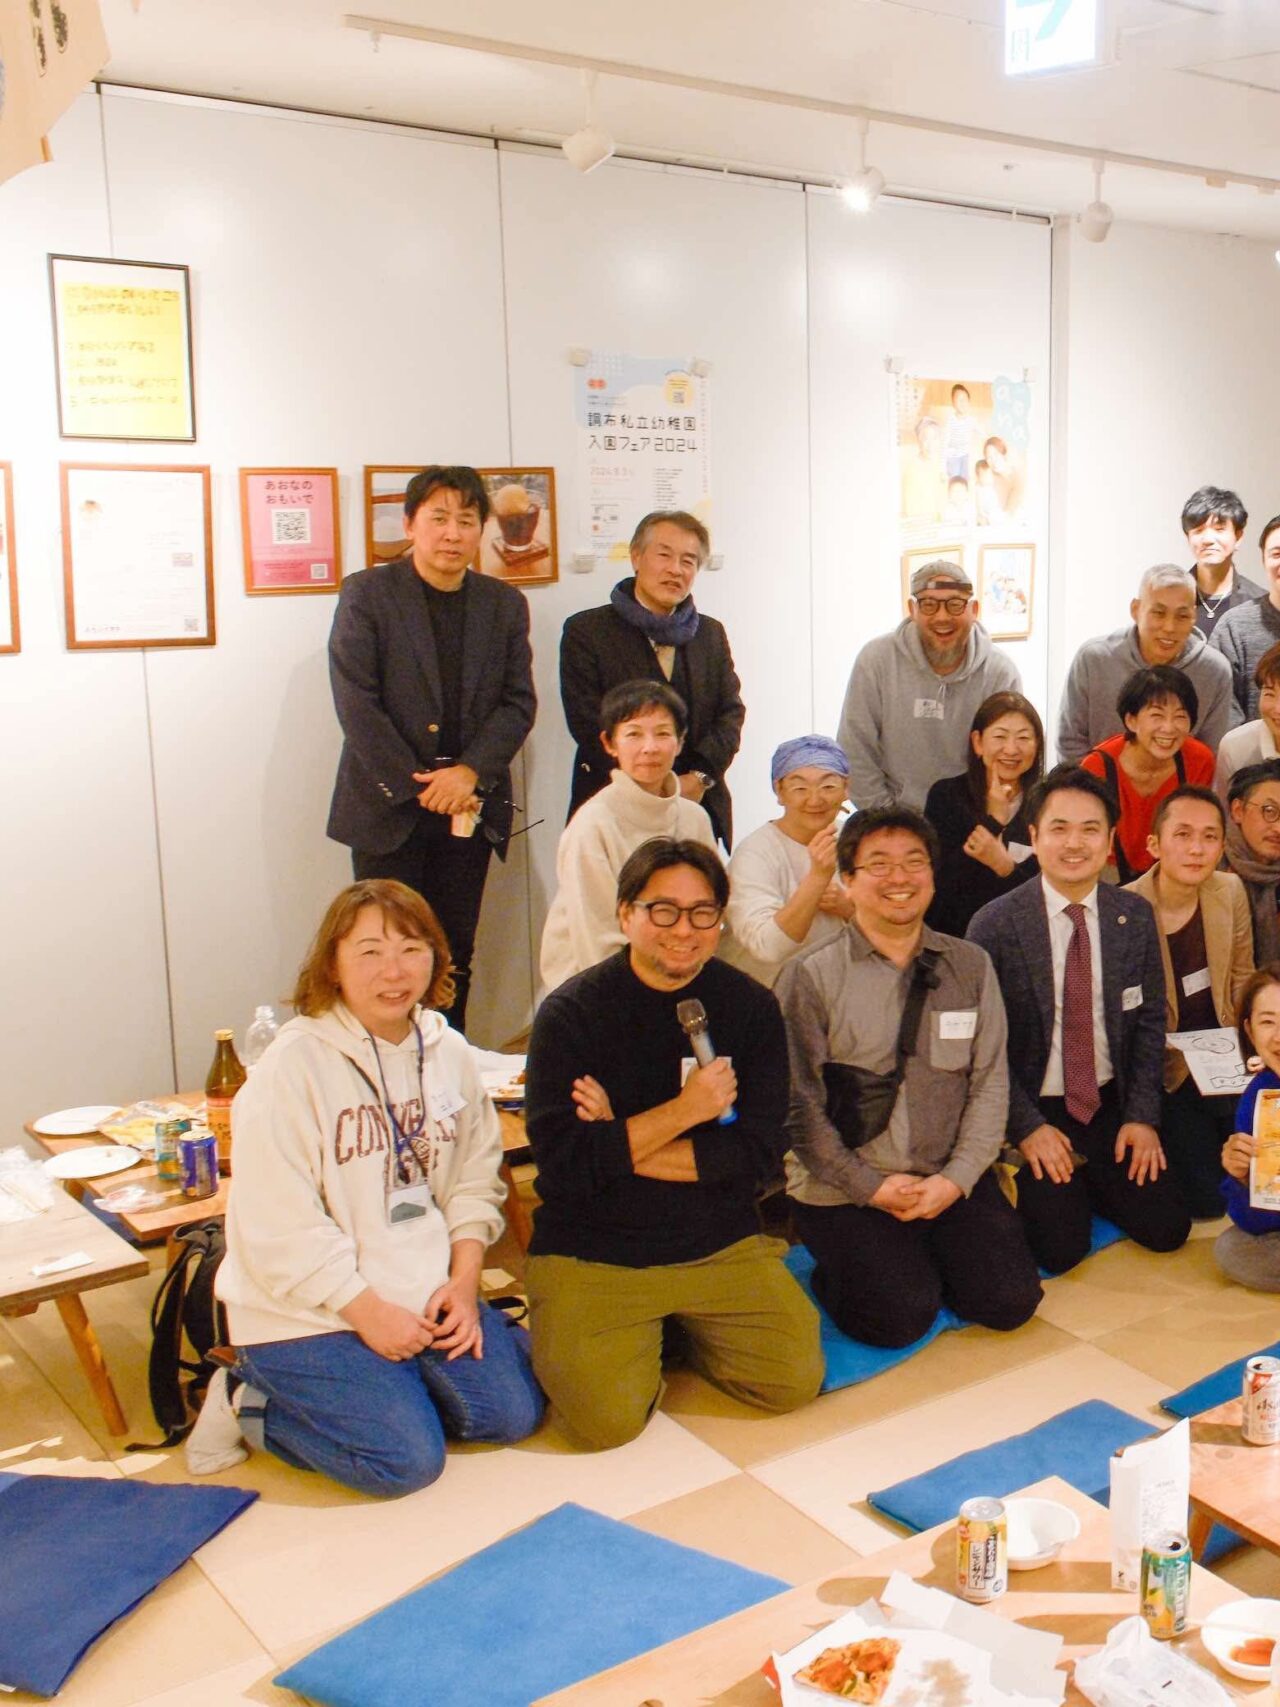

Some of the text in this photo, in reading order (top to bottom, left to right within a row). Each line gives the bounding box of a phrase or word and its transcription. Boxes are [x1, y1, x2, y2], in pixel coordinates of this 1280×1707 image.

[588, 412, 696, 431] 調布私立幼稚園
[589, 435, 698, 452] 入園フェア2024
[265, 480, 314, 491] あおなの
[266, 494, 315, 505] おもいで
